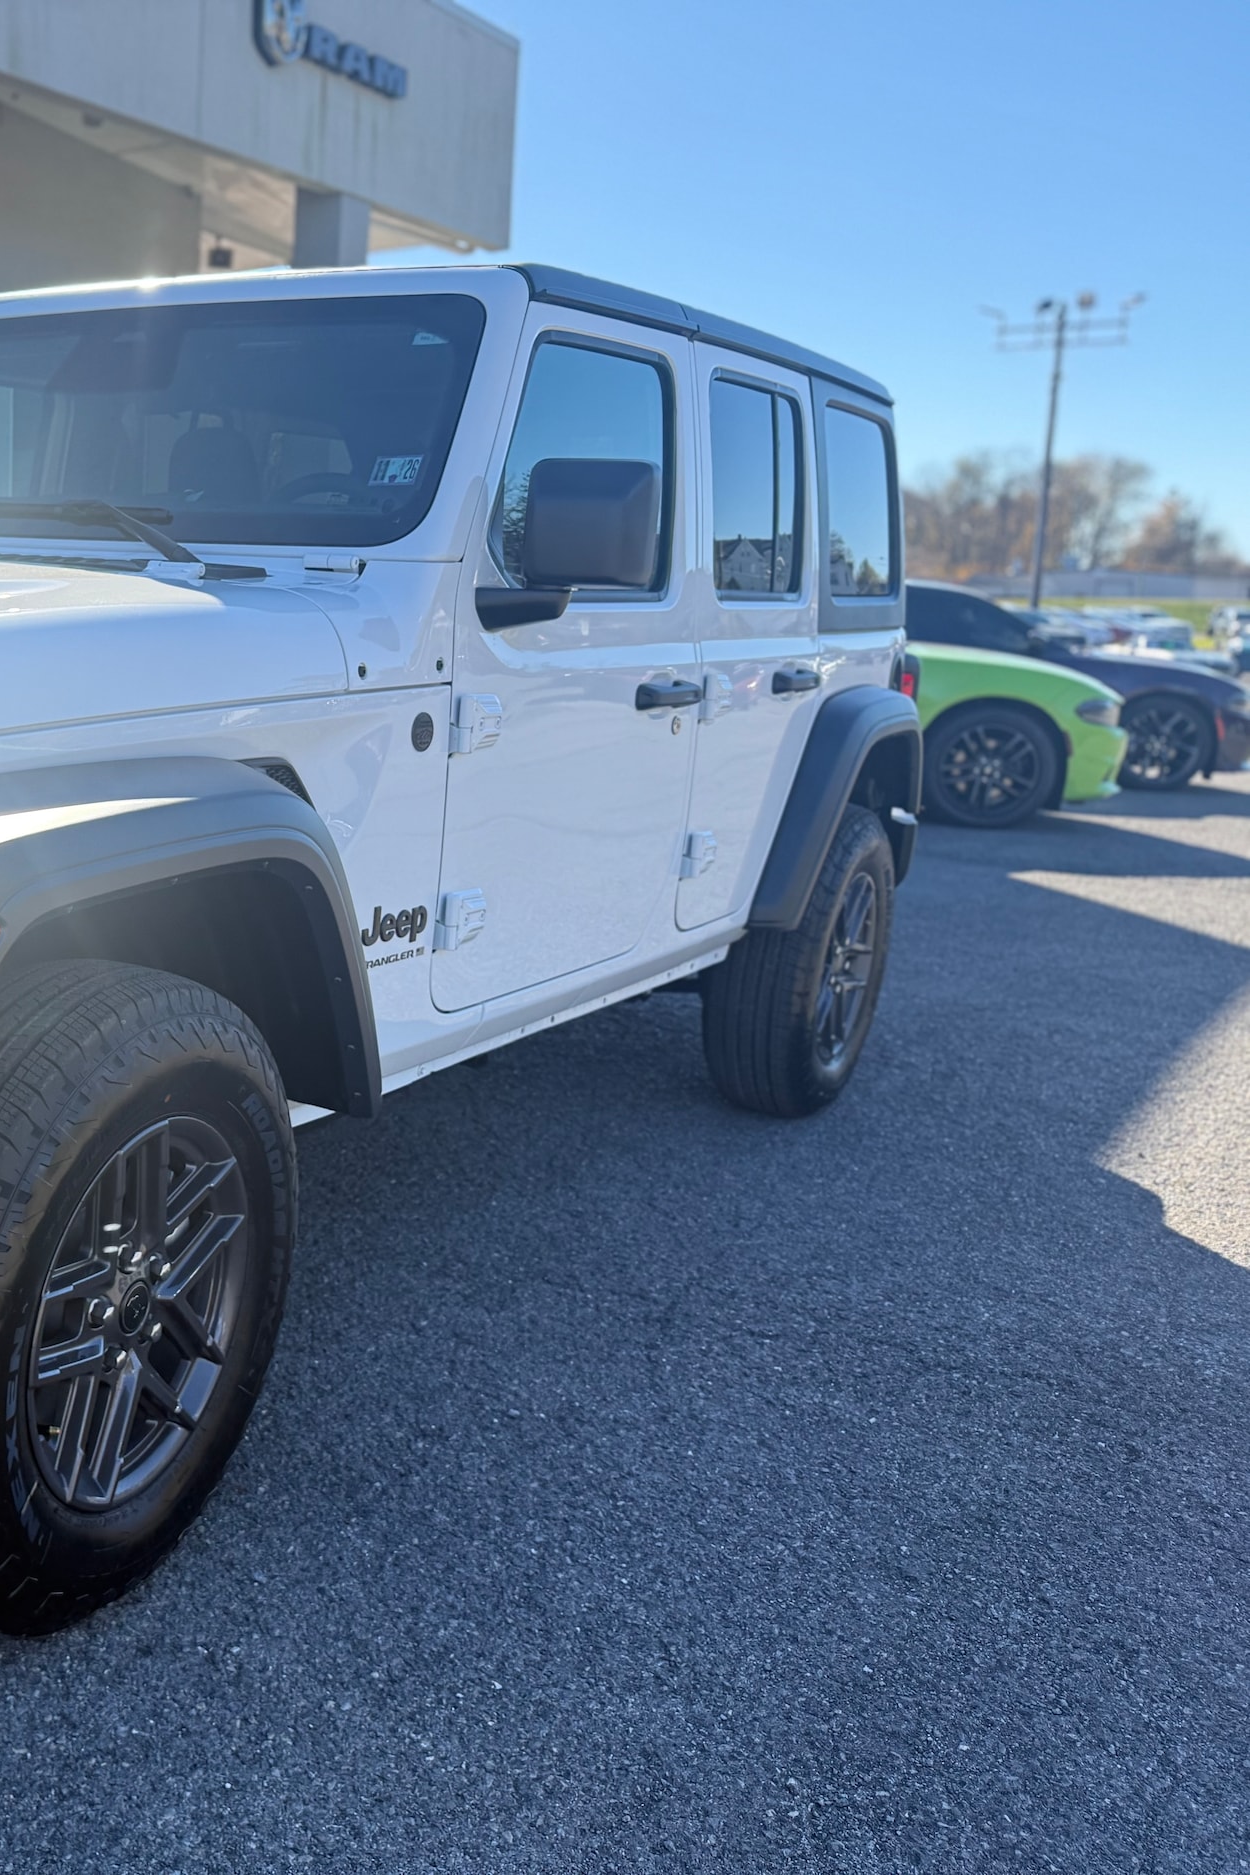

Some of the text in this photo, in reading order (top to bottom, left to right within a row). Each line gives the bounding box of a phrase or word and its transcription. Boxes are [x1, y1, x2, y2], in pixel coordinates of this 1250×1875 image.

[302, 23, 407, 99] RAM
[361, 905, 428, 947] Jeep
[365, 950, 414, 969] RANGLER
[241, 1093, 287, 1236] ROADIAN
[6, 1324, 40, 1544] NEXEN
